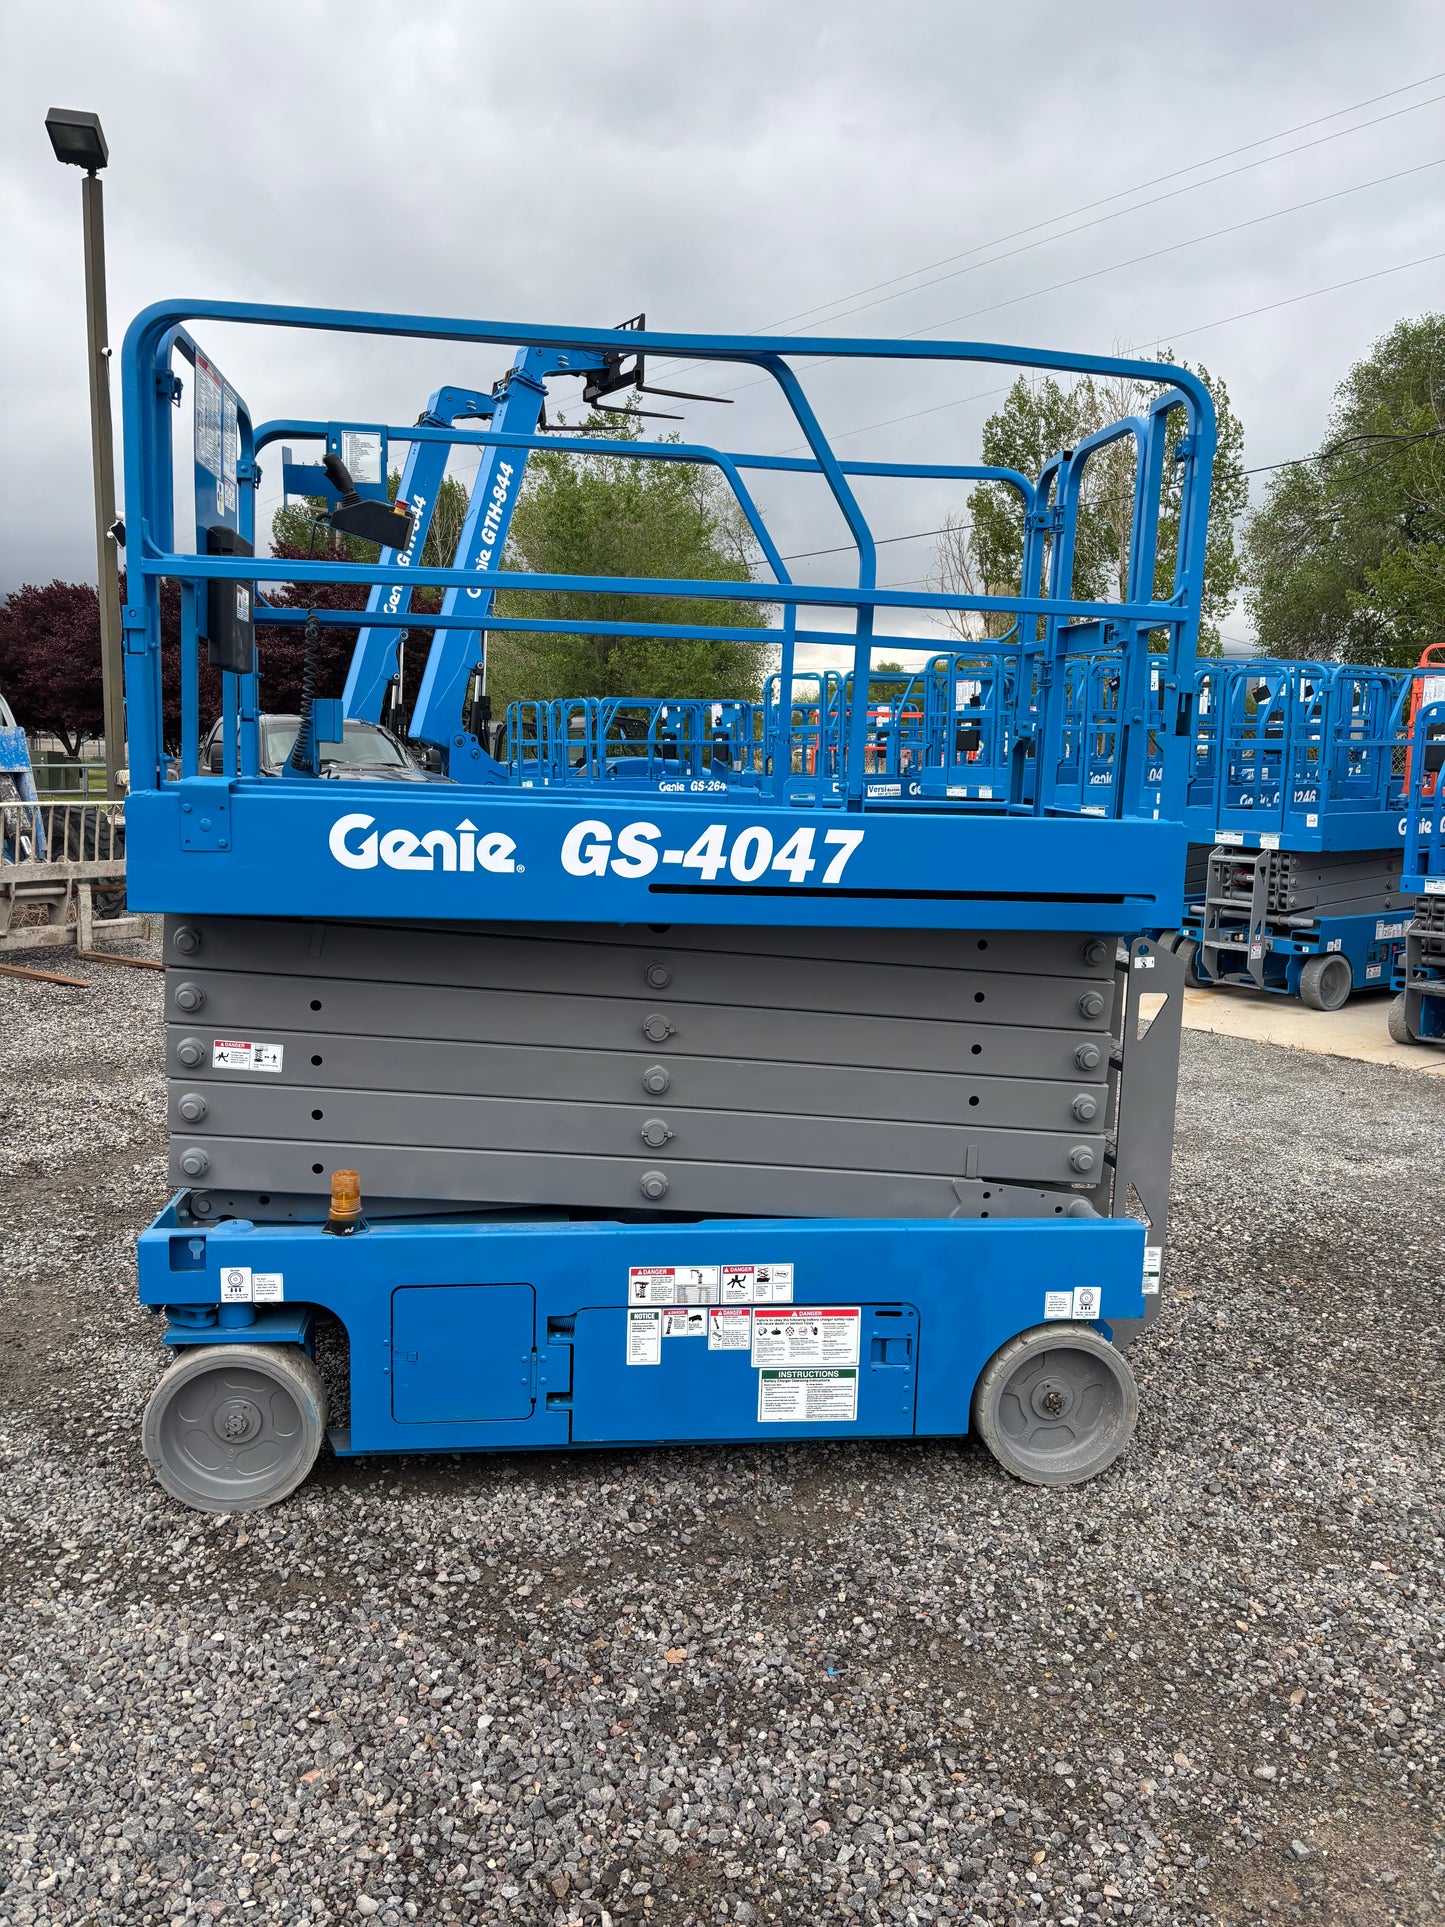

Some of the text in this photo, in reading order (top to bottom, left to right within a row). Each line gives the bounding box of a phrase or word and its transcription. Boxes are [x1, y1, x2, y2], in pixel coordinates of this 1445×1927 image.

[481, 461, 514, 545] GTH-844
[658, 780, 728, 792] Genie GS-264
[329, 813, 865, 885] Genie GS-4047
[633, 1312, 655, 1320] NOTICE
[778, 1370, 839, 1378] INSTRUCTIONS
